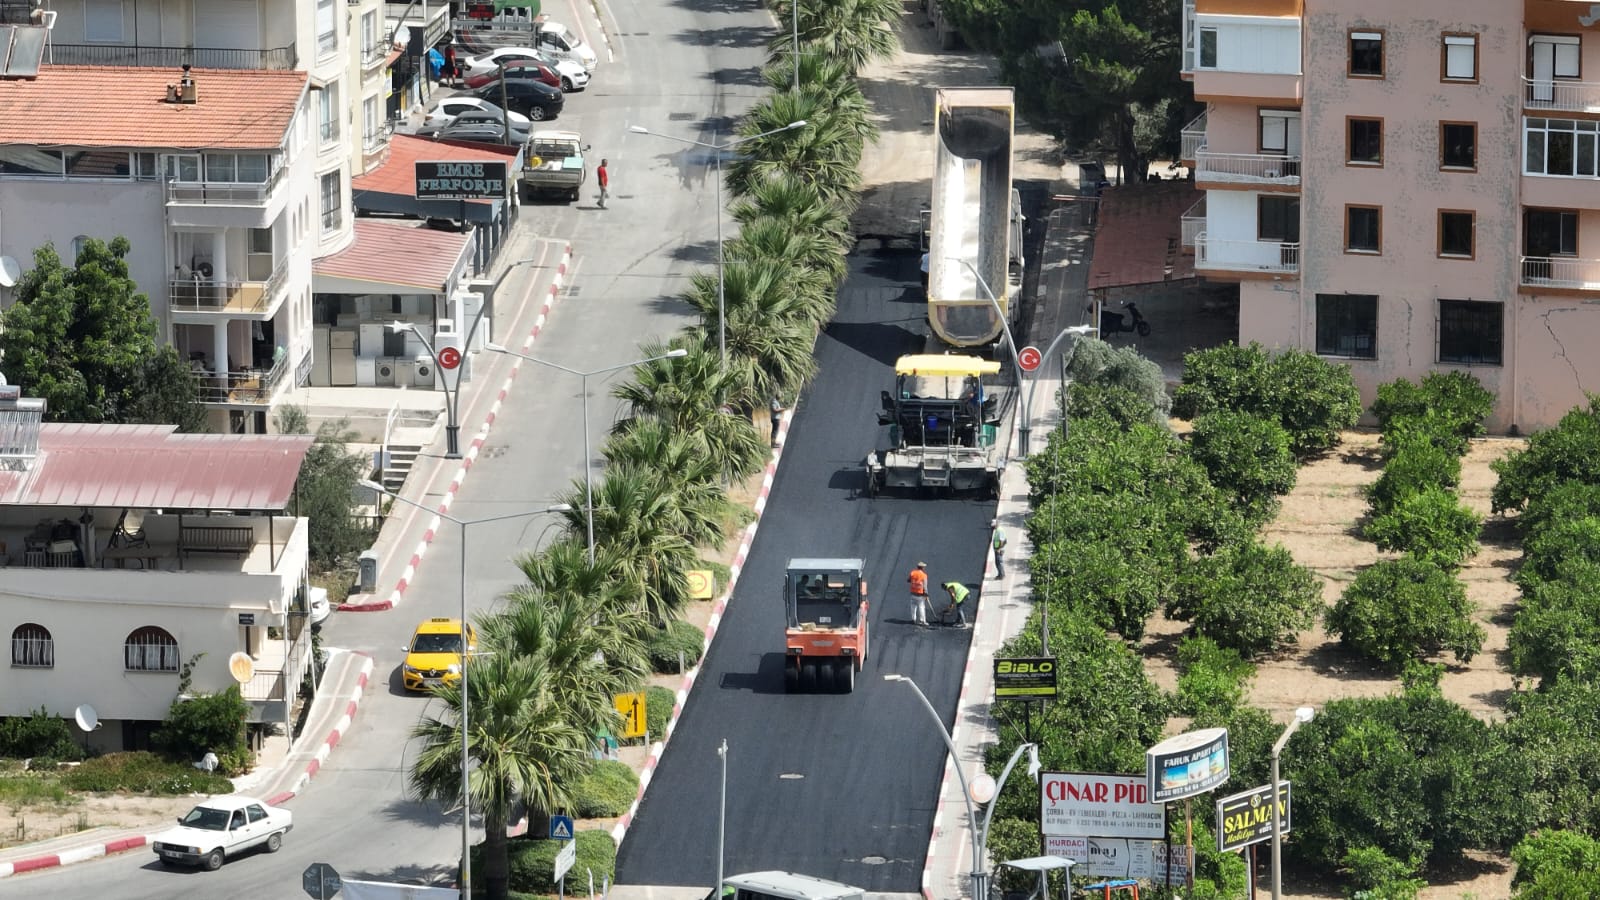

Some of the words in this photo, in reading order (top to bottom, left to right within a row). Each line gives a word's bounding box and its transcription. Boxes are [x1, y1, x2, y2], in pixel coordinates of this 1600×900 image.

[436, 163, 485, 177] EMRE
[418, 179, 504, 194] FERFORJE
[1164, 755, 1190, 767] FARUK
[1191, 747, 1211, 762] APART
[1046, 780, 1108, 806] ÇINAR
[1114, 779, 1147, 804] PİD
[1049, 839, 1085, 847] HURDACI
